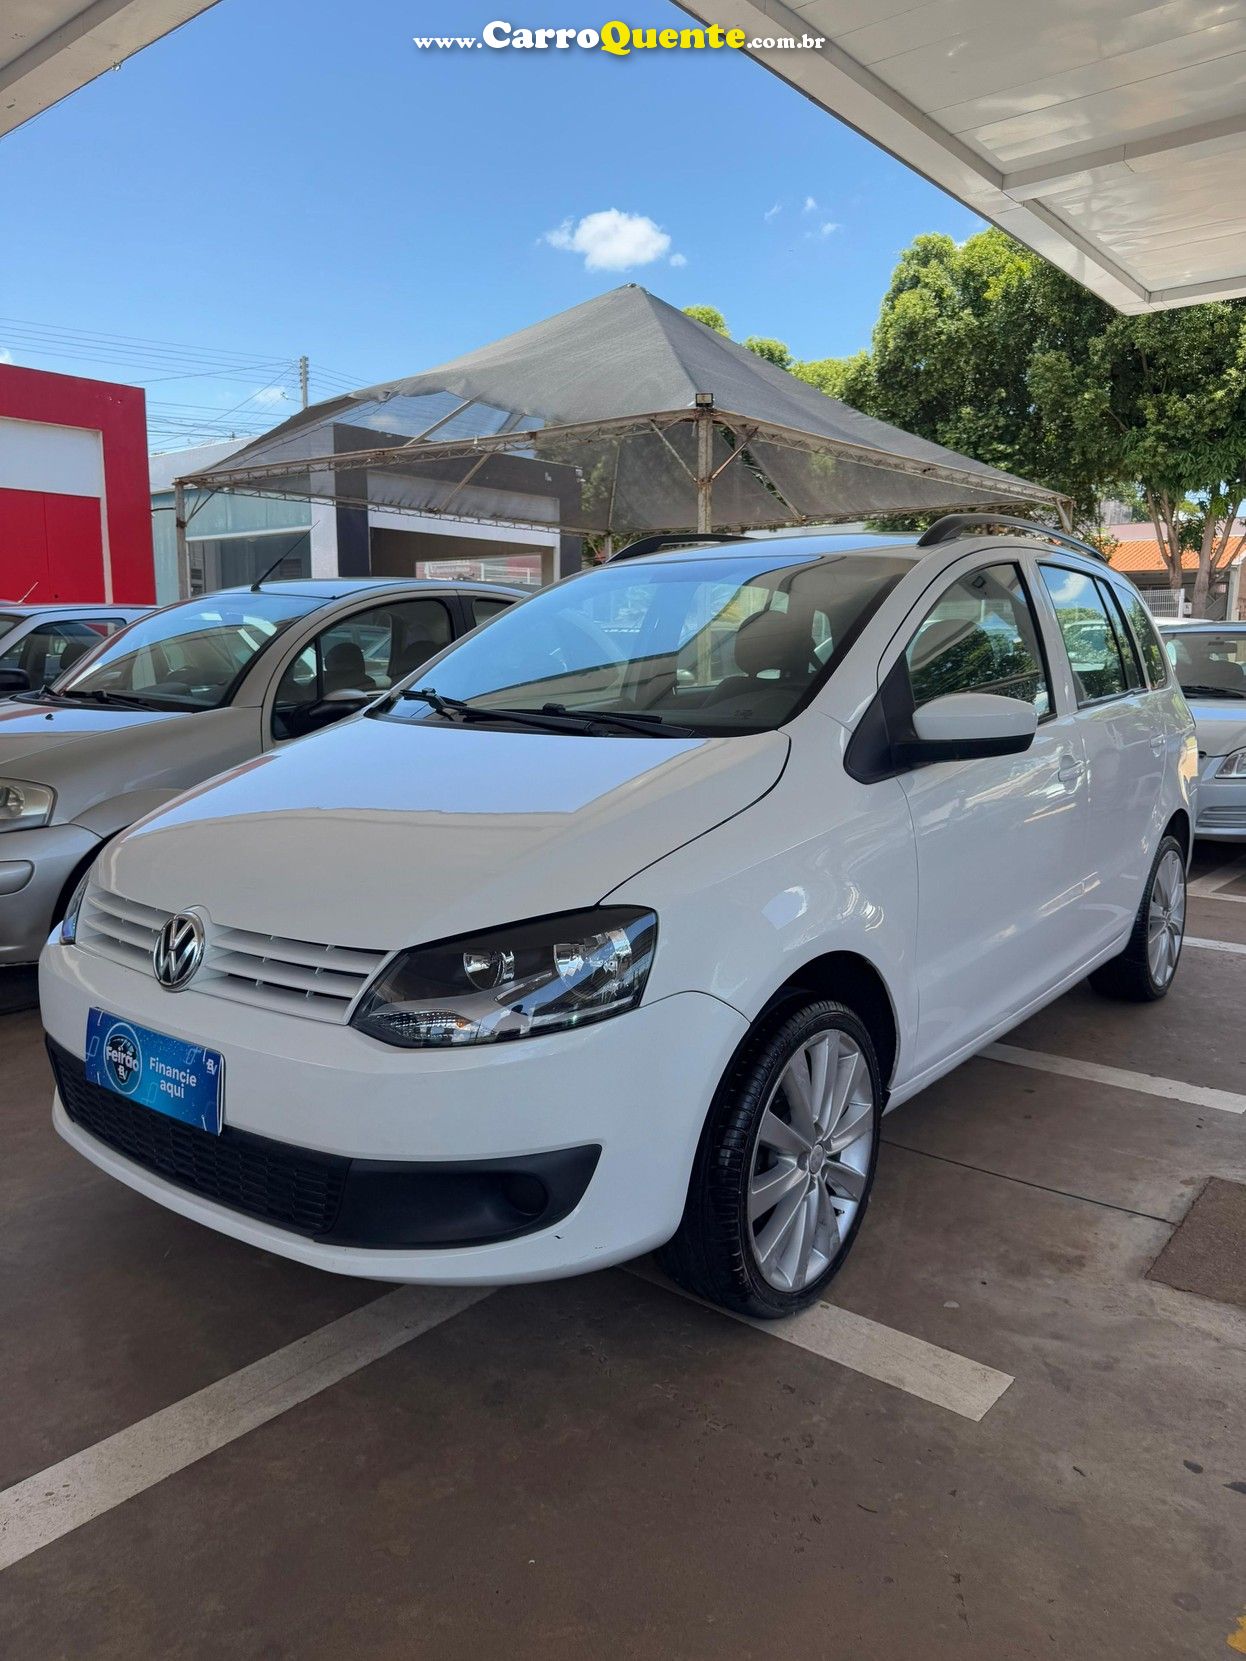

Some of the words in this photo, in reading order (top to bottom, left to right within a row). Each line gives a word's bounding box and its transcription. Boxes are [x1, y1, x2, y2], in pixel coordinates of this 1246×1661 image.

[106, 1046, 139, 1072] Feirão
[150, 1057, 197, 1087] Financie
[160, 1079, 185, 1099] aqui
